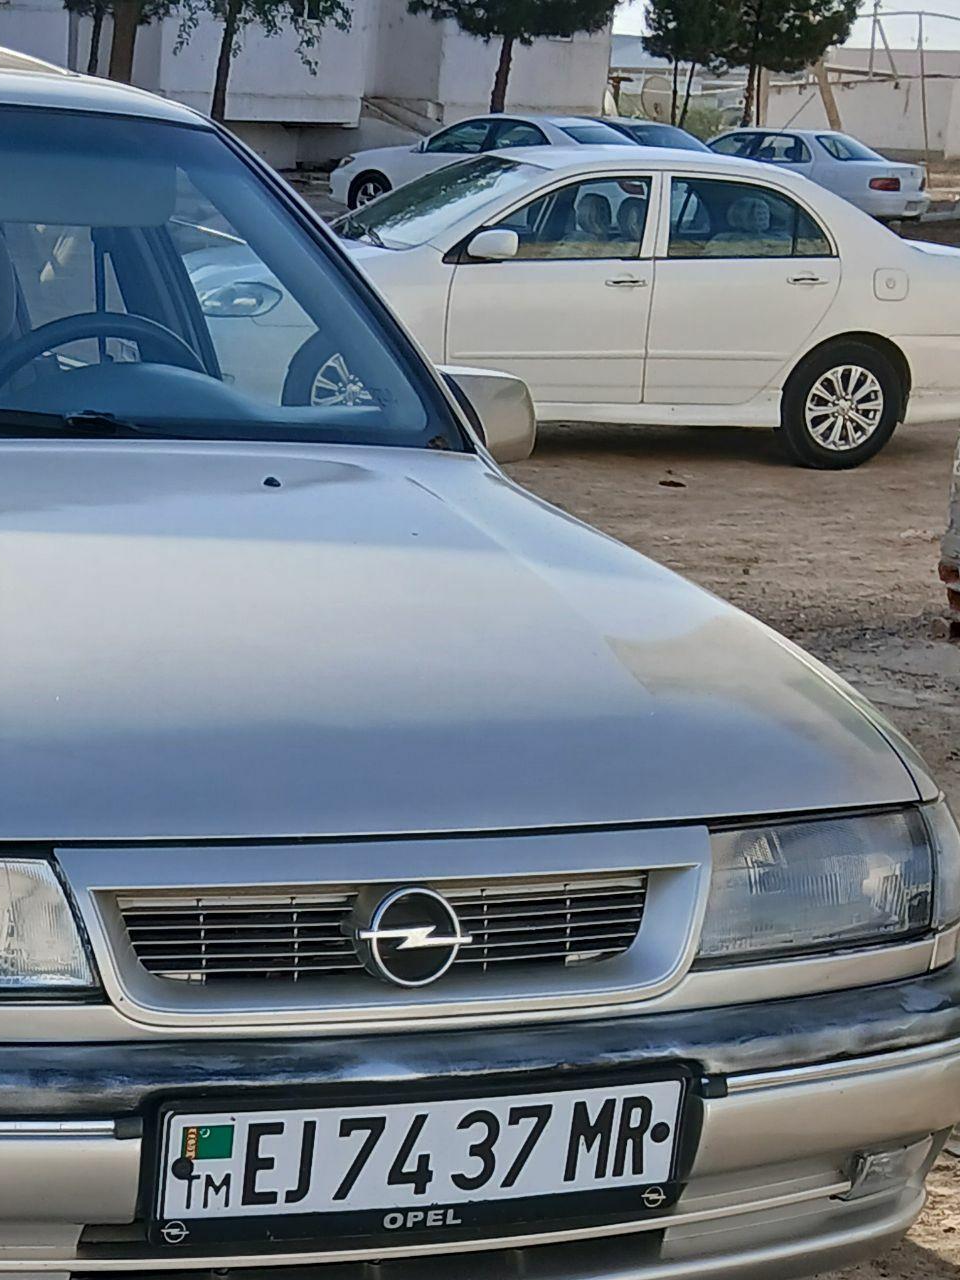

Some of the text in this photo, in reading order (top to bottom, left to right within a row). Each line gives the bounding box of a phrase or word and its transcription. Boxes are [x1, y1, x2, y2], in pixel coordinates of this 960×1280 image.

[563, 1095, 653, 1182] MR
[185, 1172, 232, 1210] TM
[383, 1208, 462, 1230] OPEL
